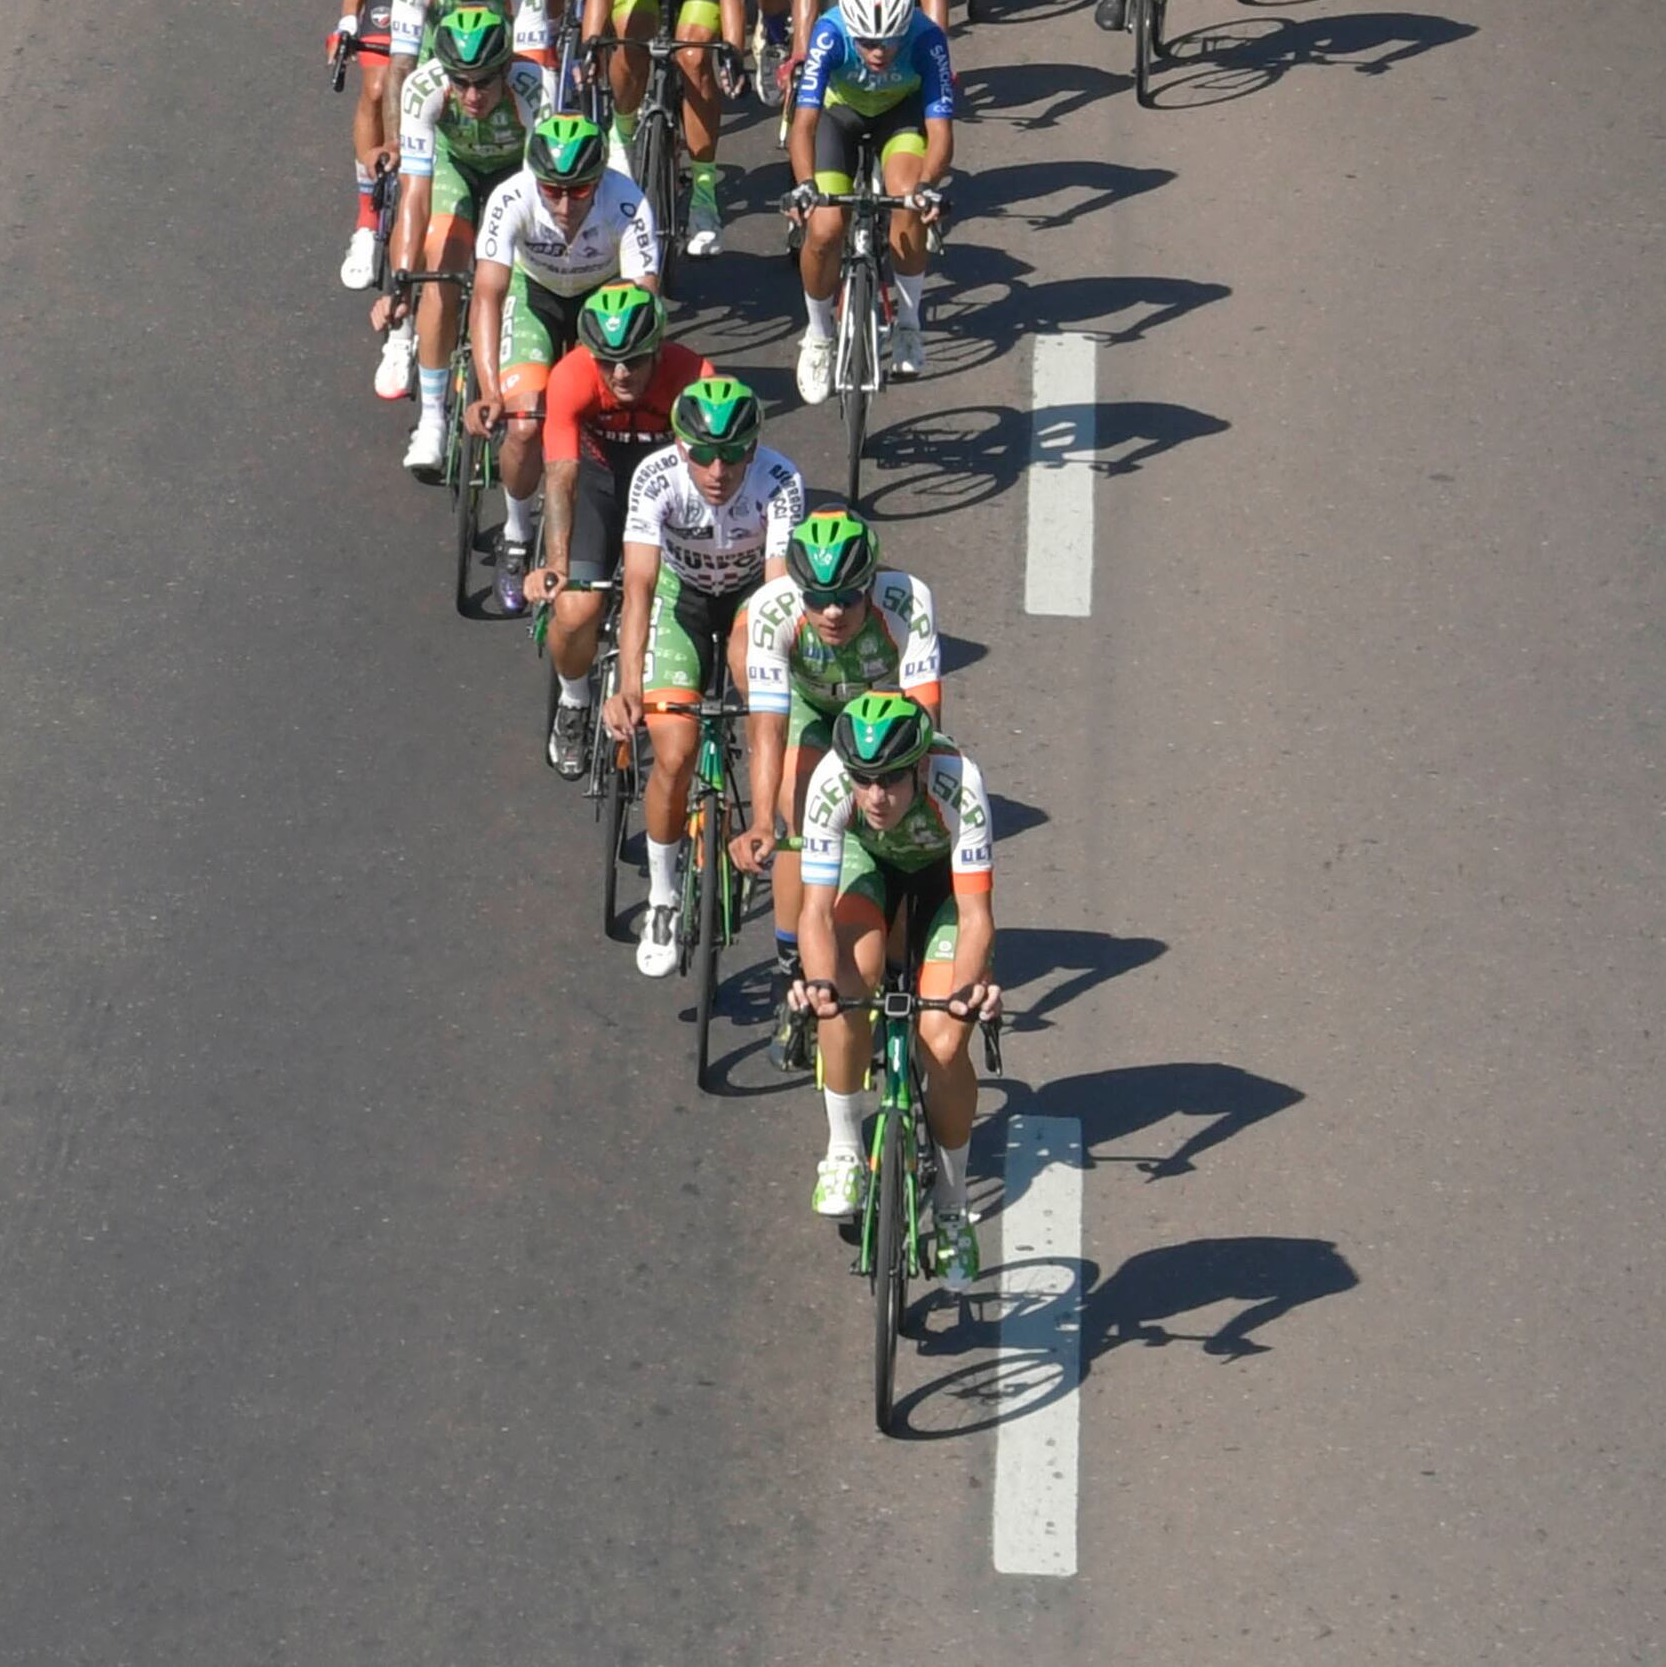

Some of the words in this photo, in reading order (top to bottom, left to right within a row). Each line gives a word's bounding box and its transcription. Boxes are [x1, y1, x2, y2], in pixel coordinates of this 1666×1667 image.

[404, 66, 448, 119] SEP
[929, 43, 955, 105] SANCHEZ
[753, 592, 796, 651] SEP
[882, 586, 931, 640] SEP
[933, 771, 986, 829] SEP
